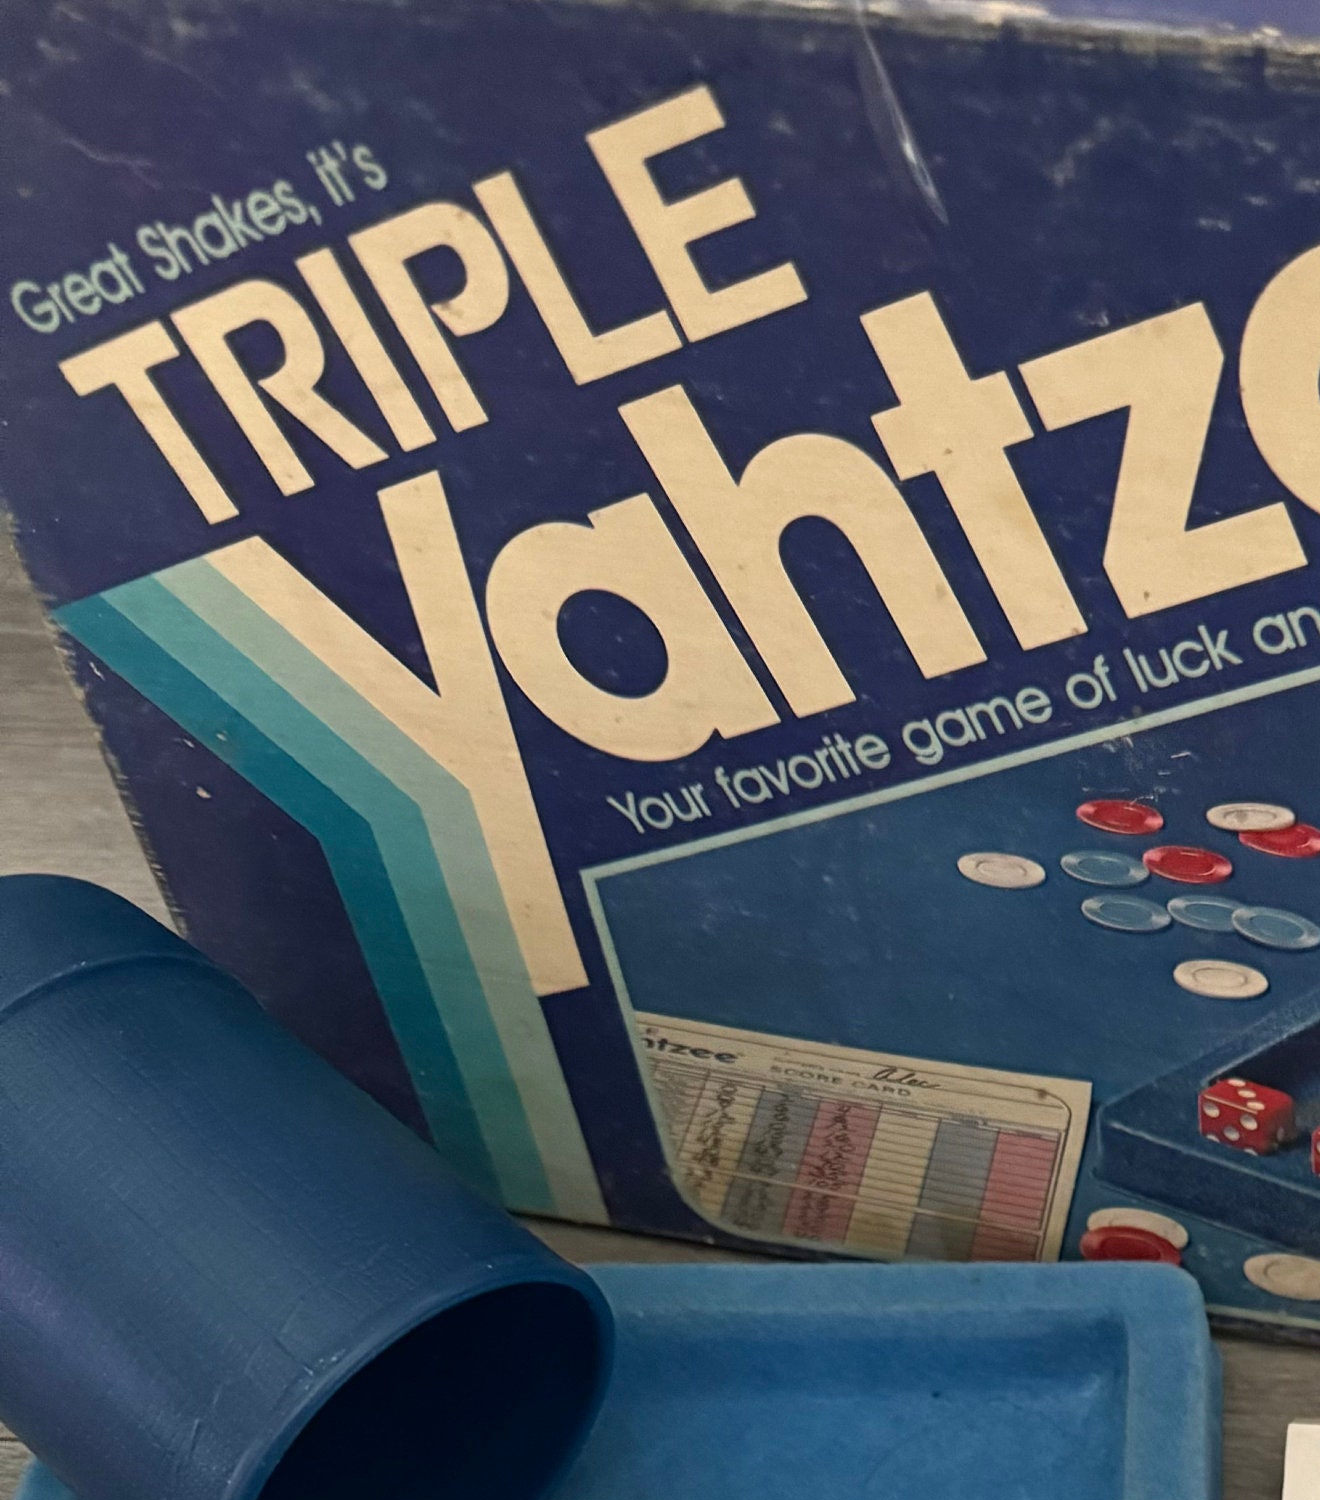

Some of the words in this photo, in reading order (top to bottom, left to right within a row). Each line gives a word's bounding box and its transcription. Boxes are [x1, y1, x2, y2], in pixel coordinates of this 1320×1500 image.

[11, 242, 146, 333] Great
[136, 180, 322, 281] Shakes,
[307, 140, 388, 207] it's
[58, 84, 808, 525] TRIPLE
[606, 781, 712, 835] Your
[715, 732, 892, 809] favorite
[902, 686, 1054, 766] game
[1065, 654, 1118, 711] of
[1123, 624, 1243, 693] luck
[770, 1064, 844, 1085] SCORE
[850, 1074, 912, 1098] CARD
